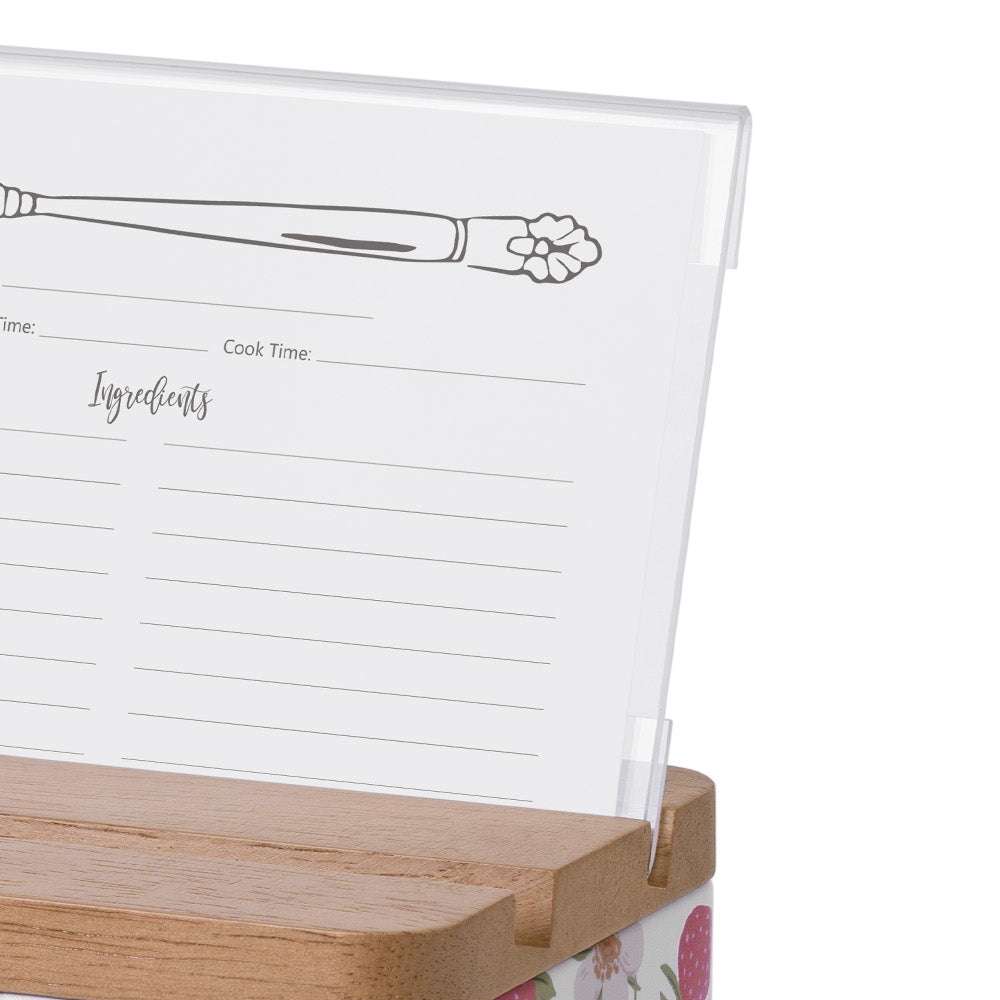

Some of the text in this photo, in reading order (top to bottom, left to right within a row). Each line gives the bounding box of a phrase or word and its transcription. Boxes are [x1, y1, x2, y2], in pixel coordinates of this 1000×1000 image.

[223, 338, 312, 362] Cook Time:
[87, 370, 213, 425] Ingredients
